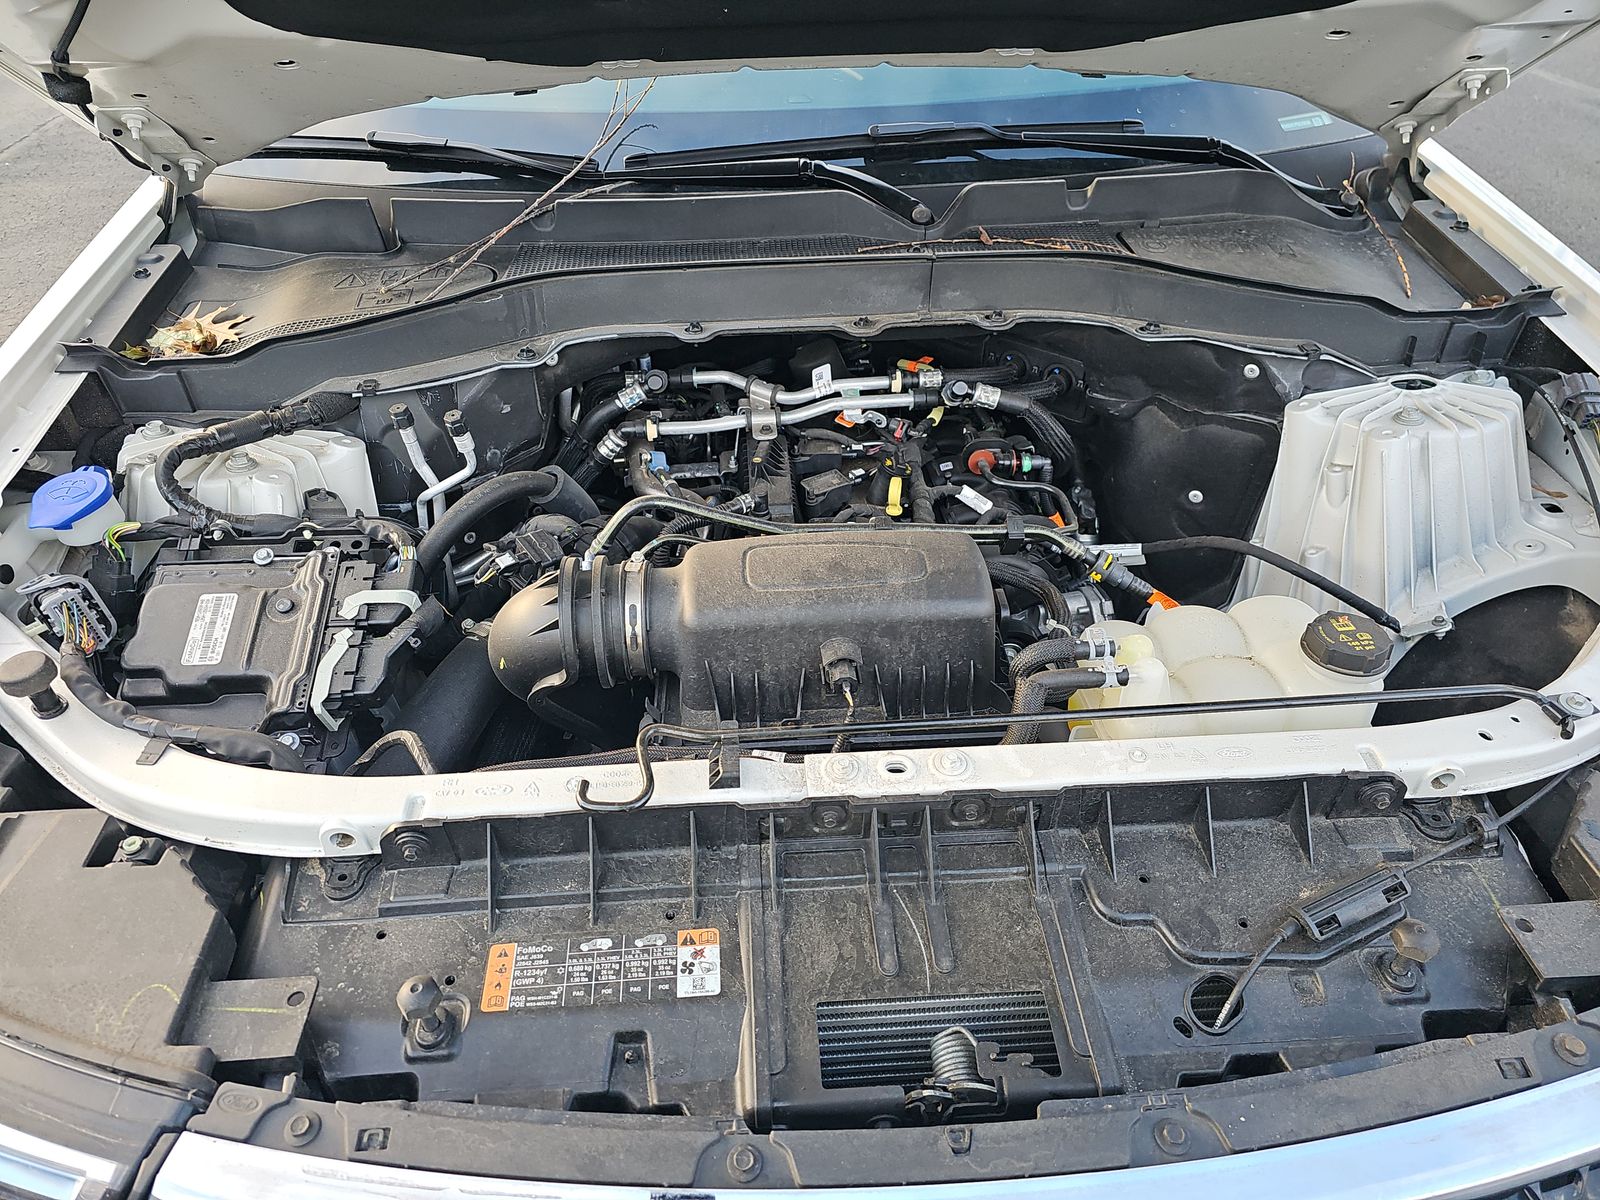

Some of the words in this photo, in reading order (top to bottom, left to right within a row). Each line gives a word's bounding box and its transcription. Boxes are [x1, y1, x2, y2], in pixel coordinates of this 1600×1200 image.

[210, 638, 219, 654] BOSCH
[517, 944, 554, 954] FoMoCo
[514, 968, 548, 976] R-1234yf
[513, 978, 535, 986] (GWP
[536, 976, 544, 984] 4)
